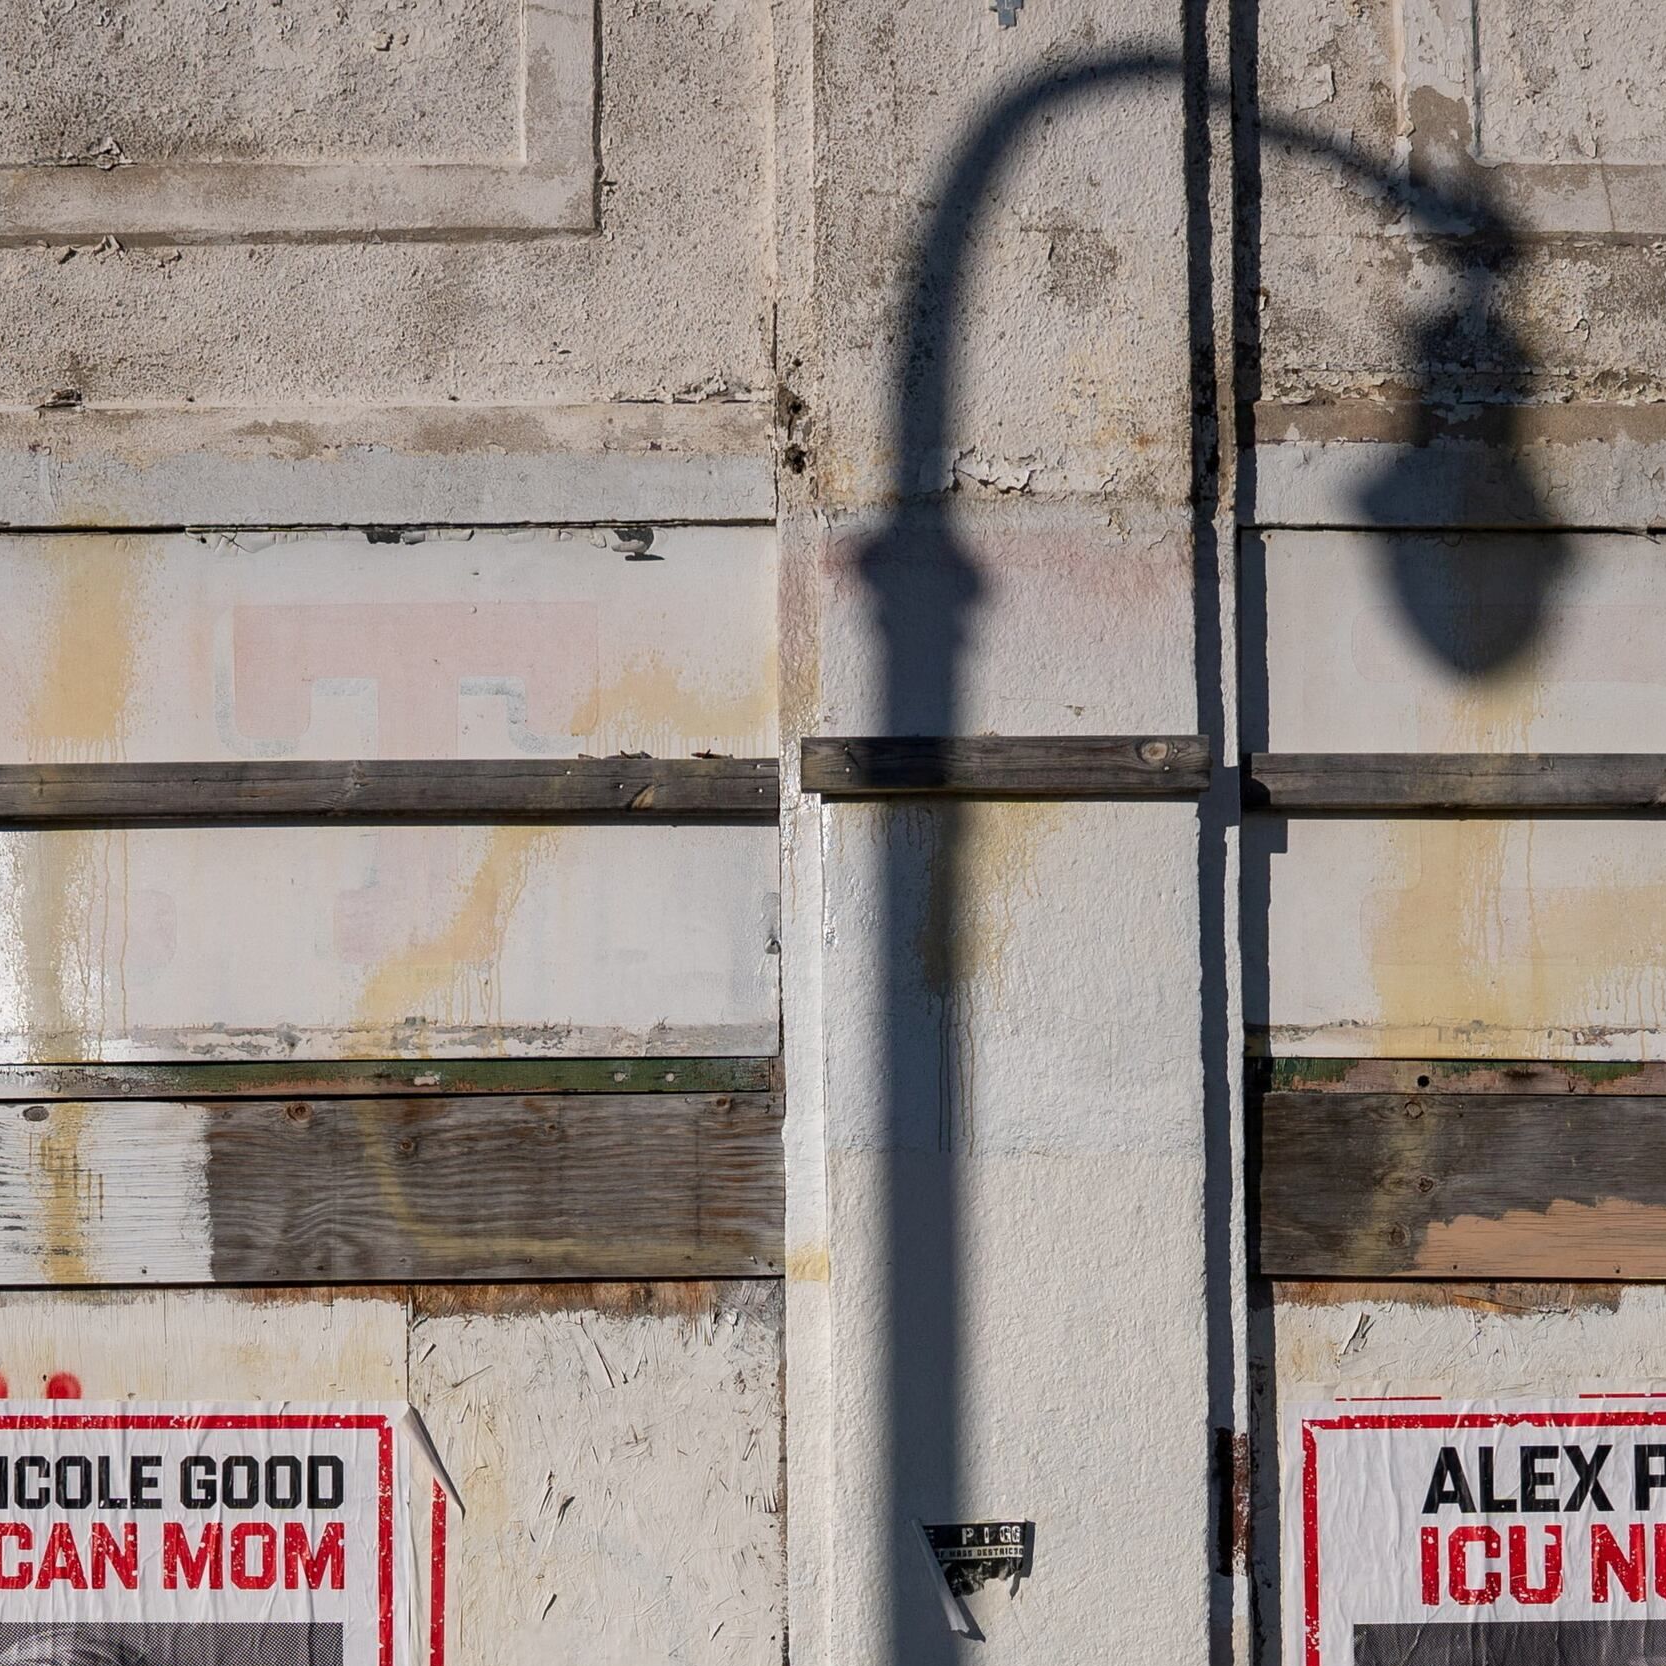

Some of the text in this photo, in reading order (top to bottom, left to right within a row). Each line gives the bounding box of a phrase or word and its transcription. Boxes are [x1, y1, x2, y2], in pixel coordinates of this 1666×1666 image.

[180, 1456, 344, 1510] GOOD
[1422, 1444, 1614, 1514] ALEX
[163, 1521, 345, 1590] MOM
[1420, 1524, 1563, 1606] ICU
